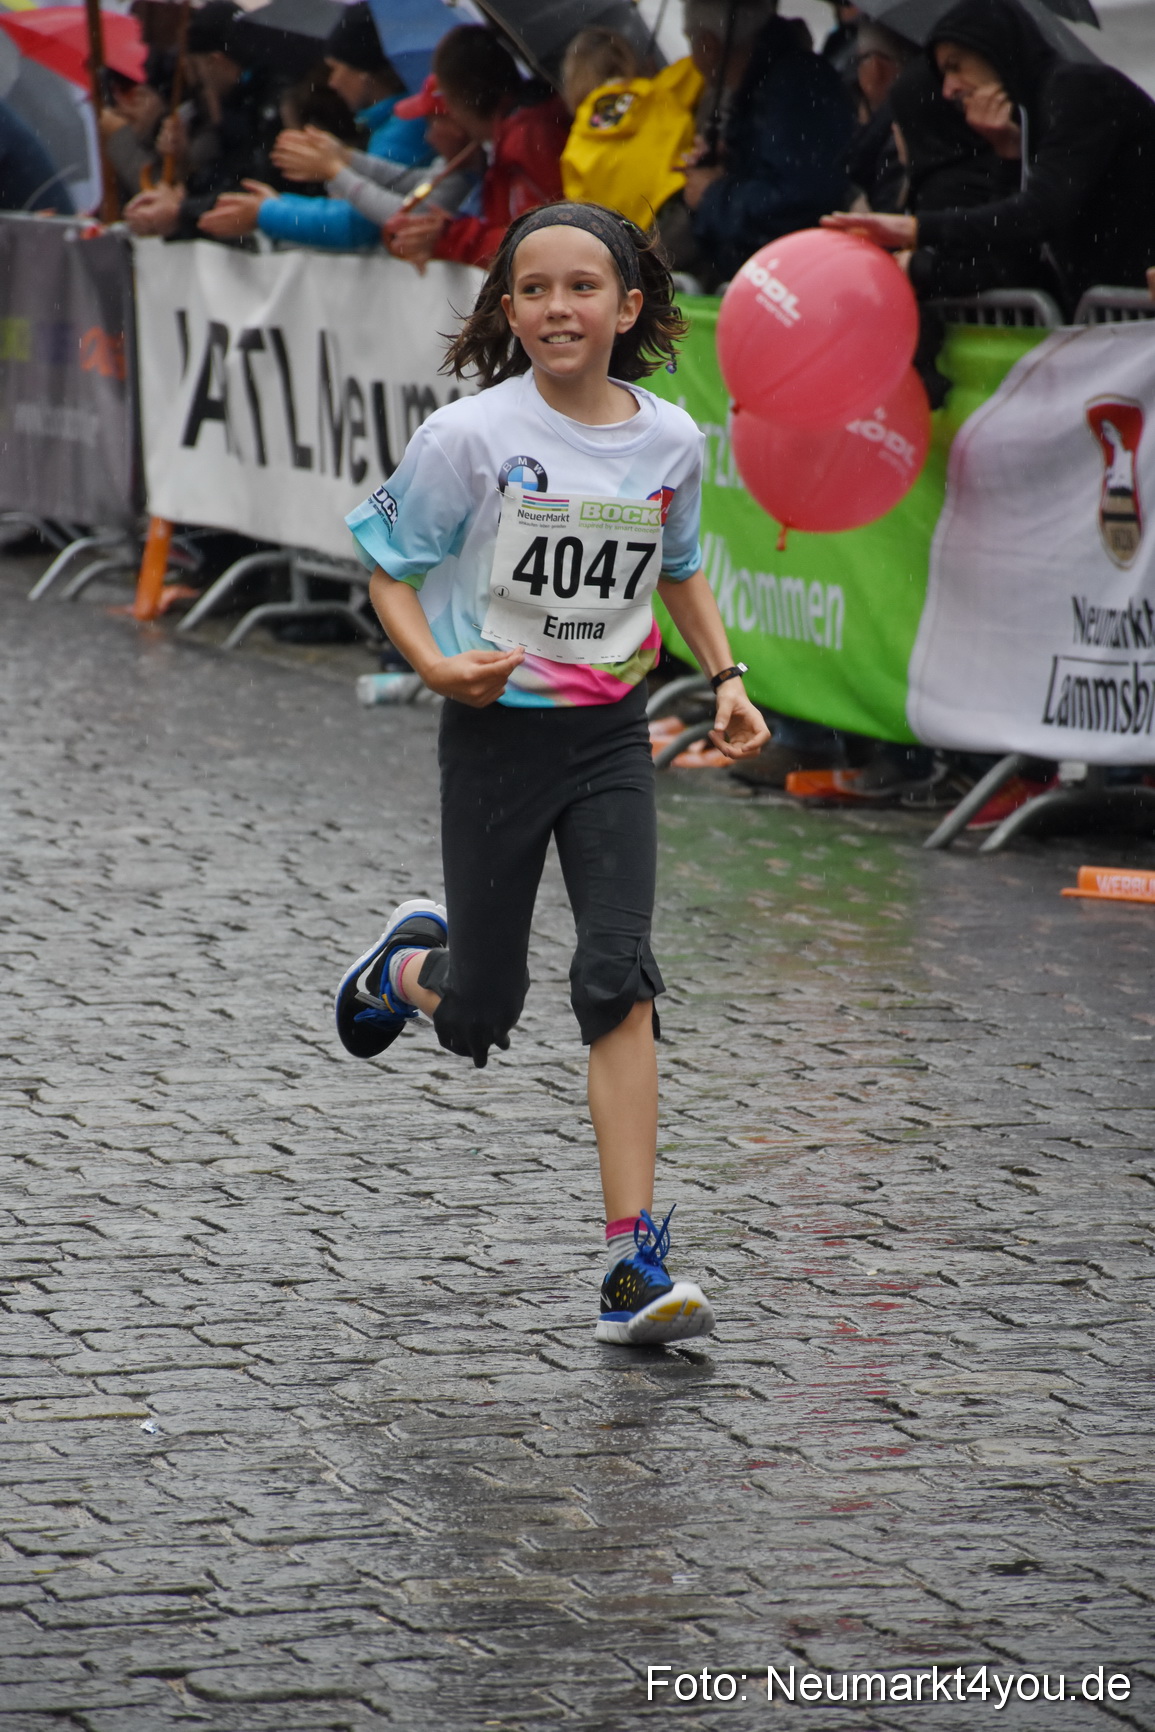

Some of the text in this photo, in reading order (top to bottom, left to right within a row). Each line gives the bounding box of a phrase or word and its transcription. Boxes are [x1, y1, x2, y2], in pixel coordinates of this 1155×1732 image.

[502, 456, 544, 475] BMW
[516, 508, 571, 523] NeuerMarkt
[580, 501, 661, 527] BOCK
[512, 536, 657, 600] 4047
[543, 614, 606, 641] Emma
